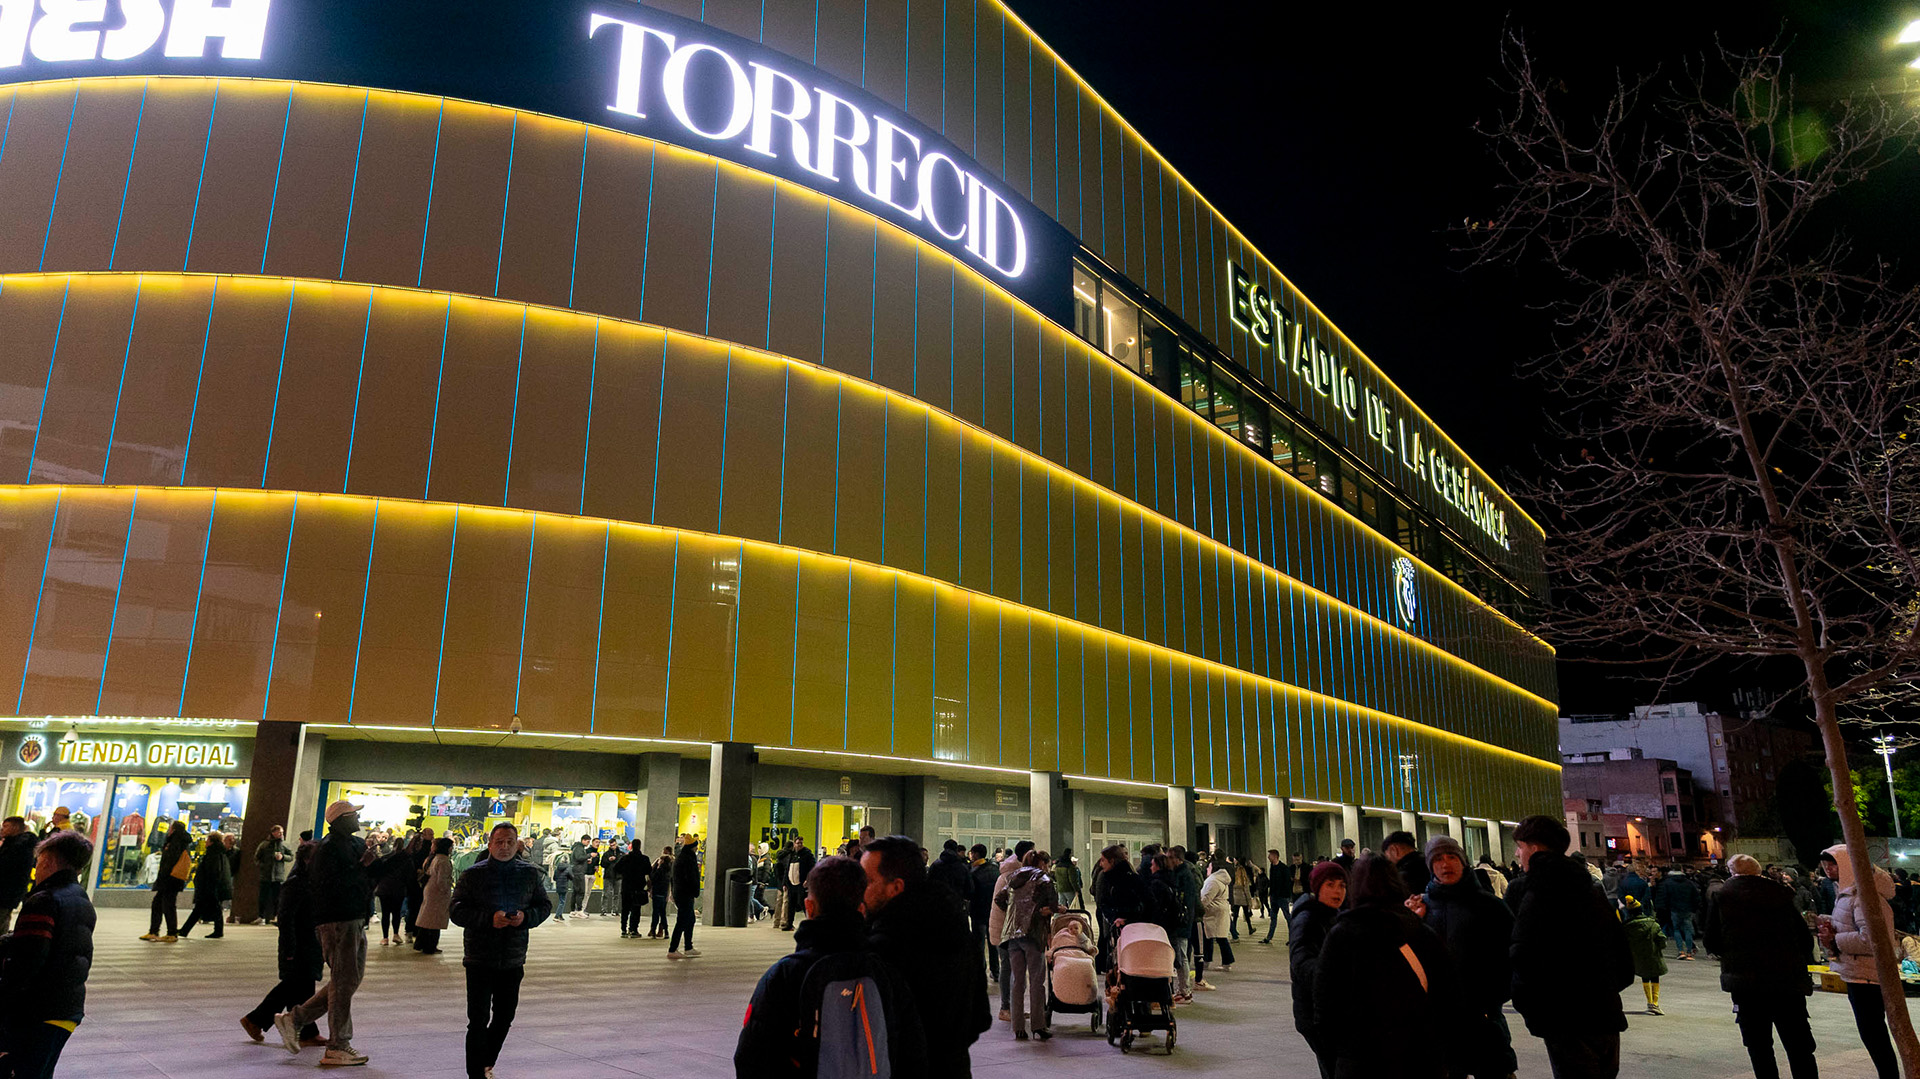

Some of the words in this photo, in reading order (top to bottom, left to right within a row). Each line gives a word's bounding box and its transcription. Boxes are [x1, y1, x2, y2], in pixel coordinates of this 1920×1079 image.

[589, 13, 1028, 279] TORRECID
[1227, 259, 1359, 421] ESTADIO
[1365, 386, 1395, 454] DE
[1399, 417, 1427, 482] LA
[58, 741, 140, 764] TIENDA
[147, 743, 237, 766] OFICIAL
